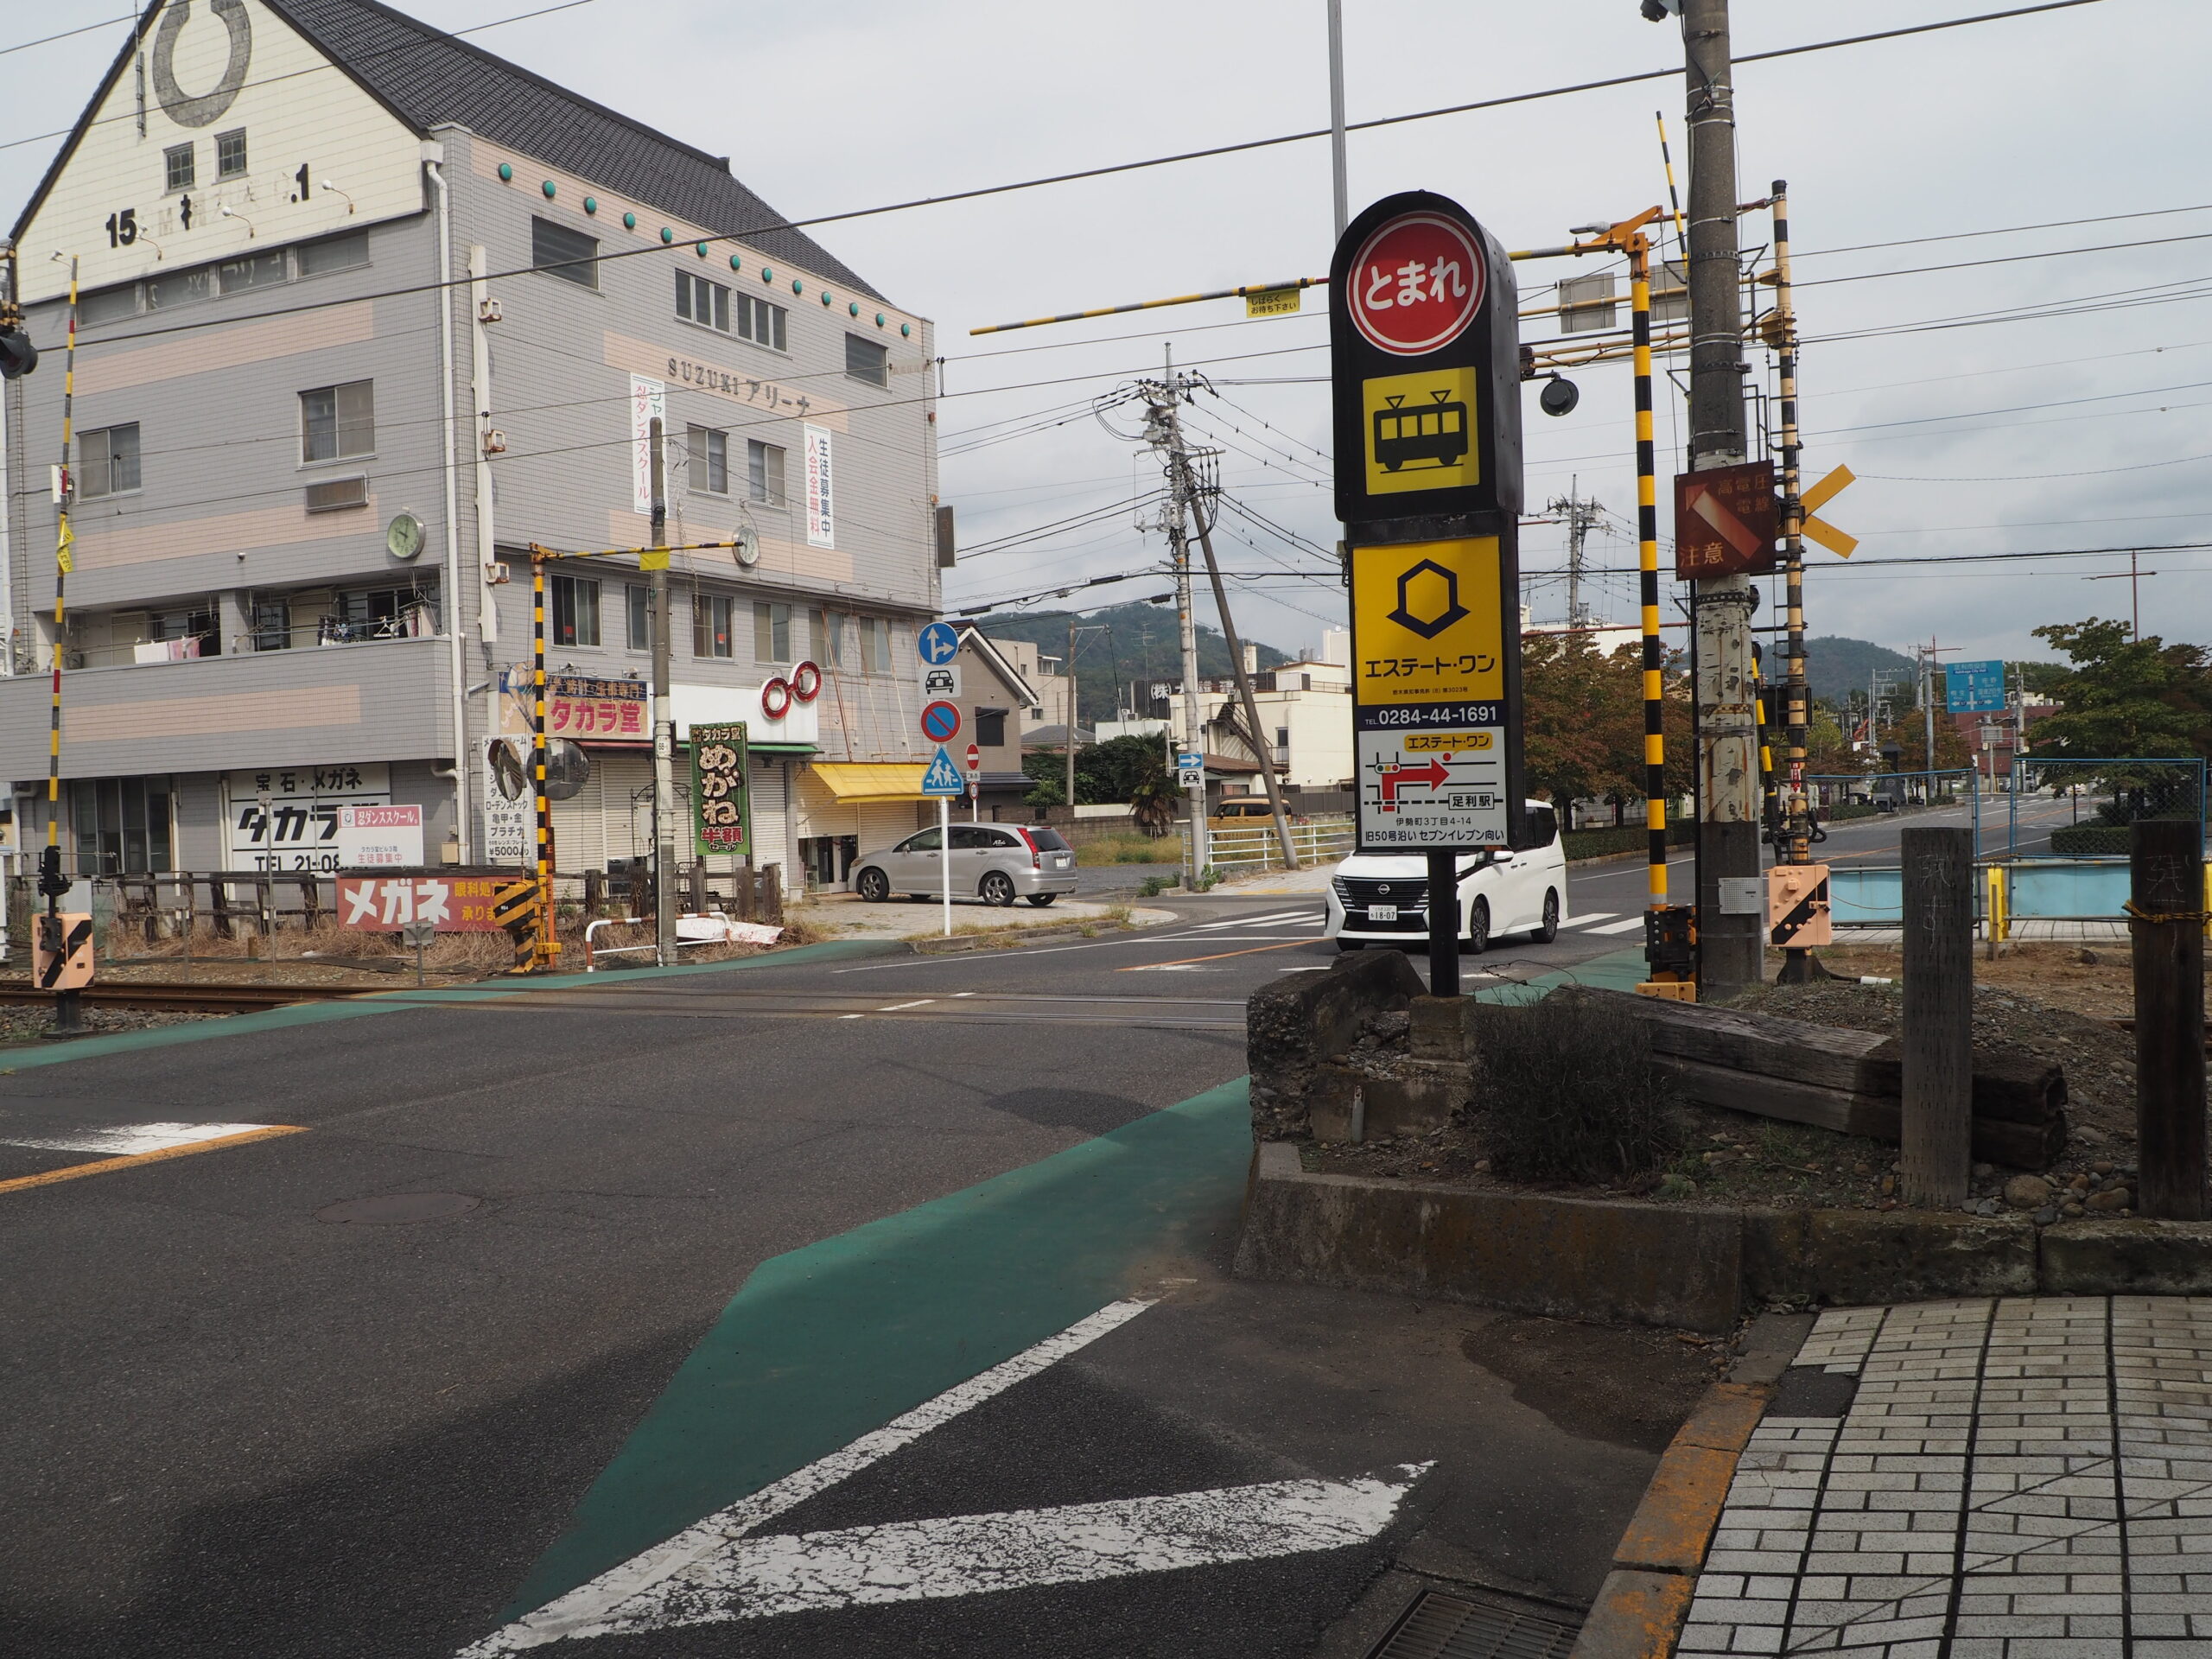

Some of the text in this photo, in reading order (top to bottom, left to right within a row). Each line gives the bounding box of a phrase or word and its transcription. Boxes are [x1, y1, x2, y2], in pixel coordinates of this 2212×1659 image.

[105, 208, 137, 248] 15
[1365, 256, 1467, 311] とまれ
[1251, 295, 1281, 306] しばらく
[1251, 302, 1296, 314] お待ち下さい
[667, 357, 810, 416] SUZUKI アリーナ
[808, 435, 820, 537] 入会金無料
[819, 437, 831, 538] 生徒募集中
[1718, 474, 1770, 496] 高電圧
[1736, 497, 1770, 514] 電線
[1679, 542, 1724, 568] 注意
[1365, 654, 1496, 678] エステート・ワン
[550, 699, 642, 734] タカラ堂
[1378, 705, 1497, 725] 0284-44-1691
[702, 727, 741, 742] タカラ堂
[1408, 735, 1489, 748] エステート・ワン
[256, 768, 362, 793] 宝石・メガネ
[699, 744, 740, 825] めがね
[486, 800, 528, 810] ローデンストック
[1452, 796, 1491, 807] 足利駅
[238, 803, 379, 842] タカラ
[493, 813, 522, 823] 亀甲・金
[1396, 817, 1471, 826] 伊勢町3丁目4-14
[490, 826, 524, 836] プラチナ
[702, 827, 743, 843] 半額
[1365, 829, 1504, 842] 旧50号沿い セブンイレブン向い
[708, 843, 736, 852] セール
[358, 853, 403, 864] 生徒募集中
[345, 878, 449, 924] メガネ
